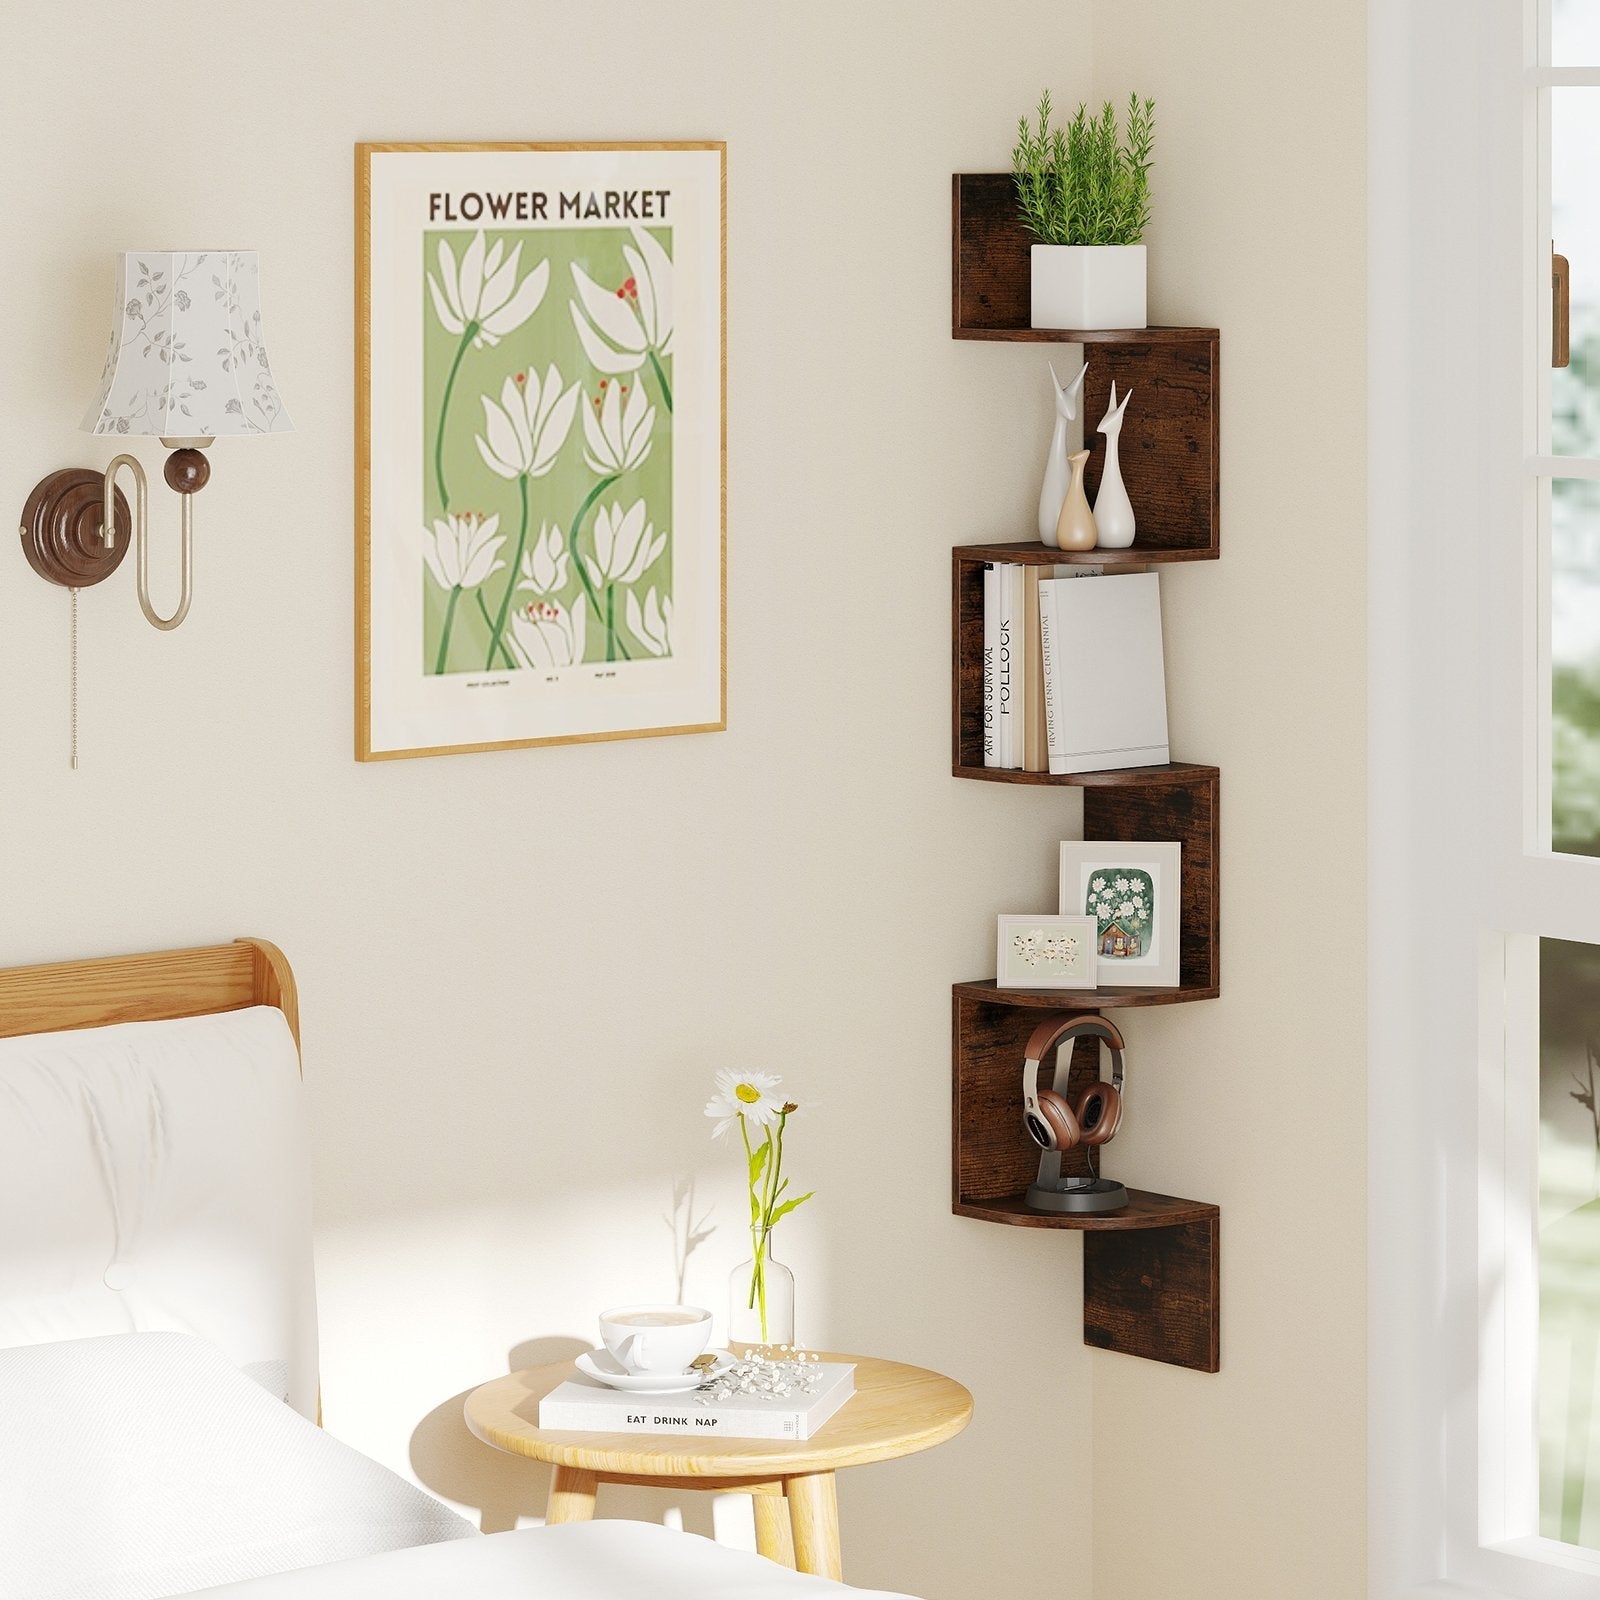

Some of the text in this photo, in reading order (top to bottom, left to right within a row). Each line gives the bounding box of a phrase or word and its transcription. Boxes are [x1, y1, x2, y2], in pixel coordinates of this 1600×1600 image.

[429, 190, 671, 221] FLOWER MARKET
[1000, 619, 1010, 715] POLLOCK
[1042, 614, 1052, 675] CENTENNIAL
[984, 646, 993, 756] ART FOR SURVIVAL
[1048, 710, 1056, 747] IRVING
[627, 1415, 718, 1427] EAT DRINK NAP
